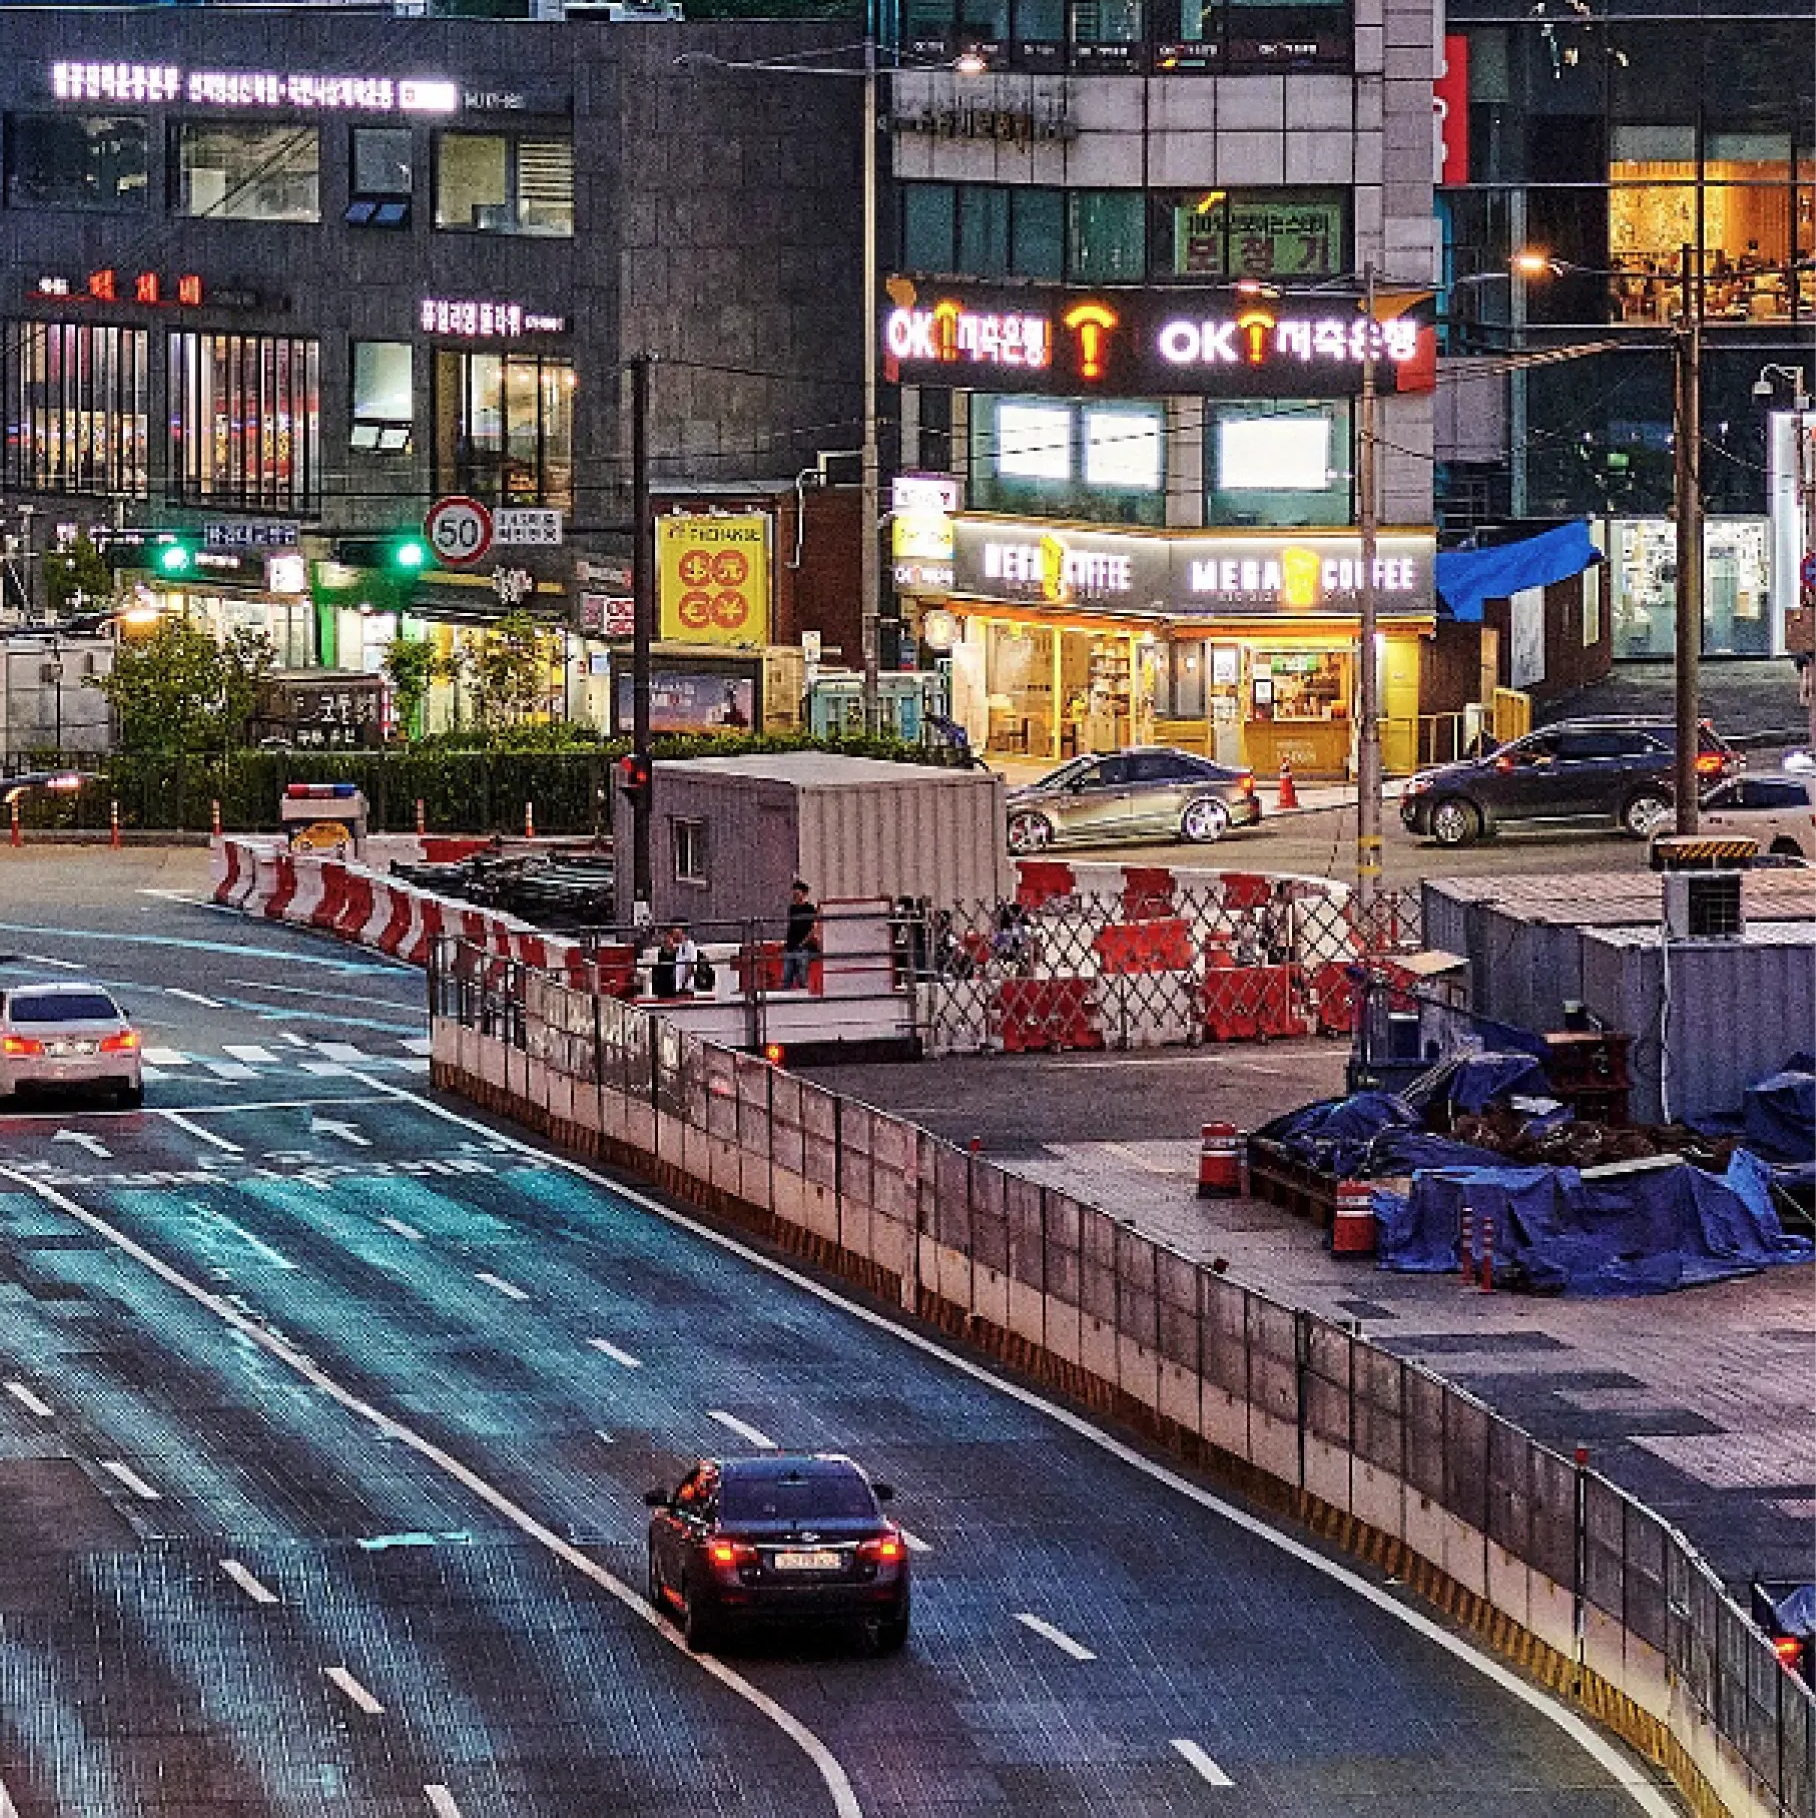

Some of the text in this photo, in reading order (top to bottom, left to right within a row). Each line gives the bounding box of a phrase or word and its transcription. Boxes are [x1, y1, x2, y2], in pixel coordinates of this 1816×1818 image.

[1158, 320, 1241, 363] OK
[437, 518, 479, 549] 50
[1191, 560, 1281, 591] MEGA
